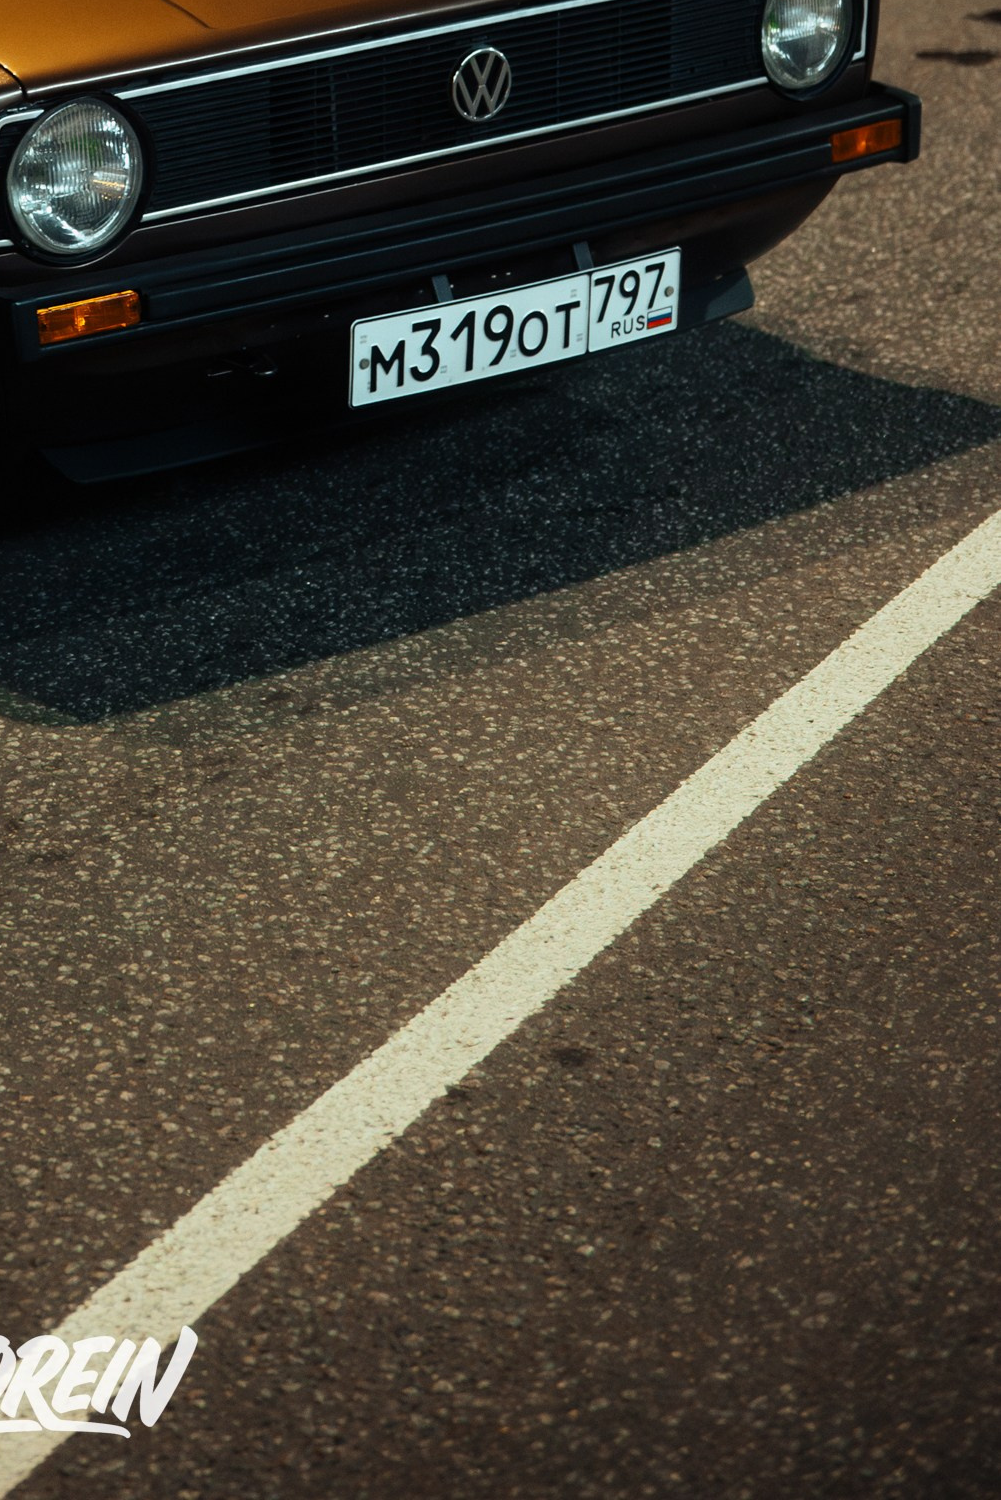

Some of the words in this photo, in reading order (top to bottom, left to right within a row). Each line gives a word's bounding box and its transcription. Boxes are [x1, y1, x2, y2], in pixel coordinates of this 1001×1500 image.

[454, 48, 511, 120] VW
[594, 262, 666, 324] 797
[610, 316, 646, 339] RUS
